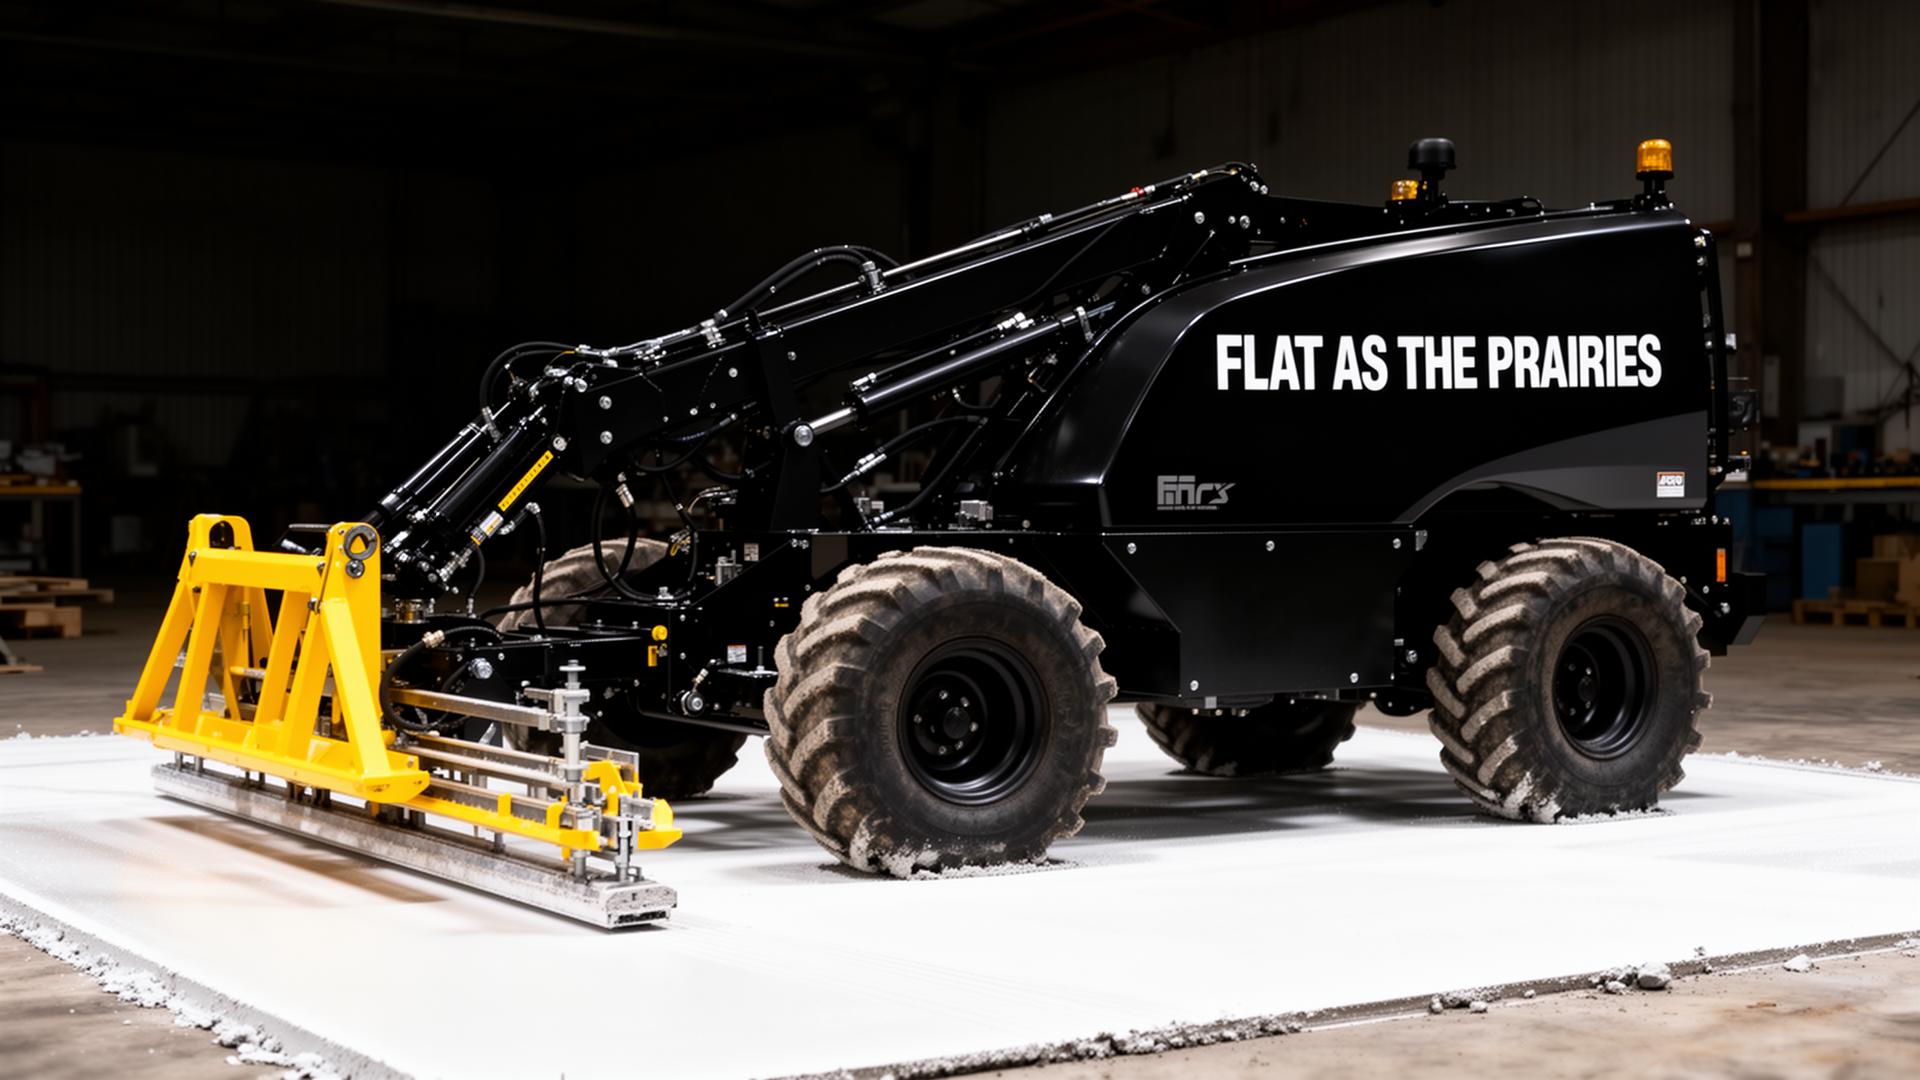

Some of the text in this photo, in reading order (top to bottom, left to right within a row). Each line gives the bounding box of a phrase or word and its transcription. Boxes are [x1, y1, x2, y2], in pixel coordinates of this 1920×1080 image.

[1216, 333, 1662, 392] FLAT AS THE PRAIRIES
